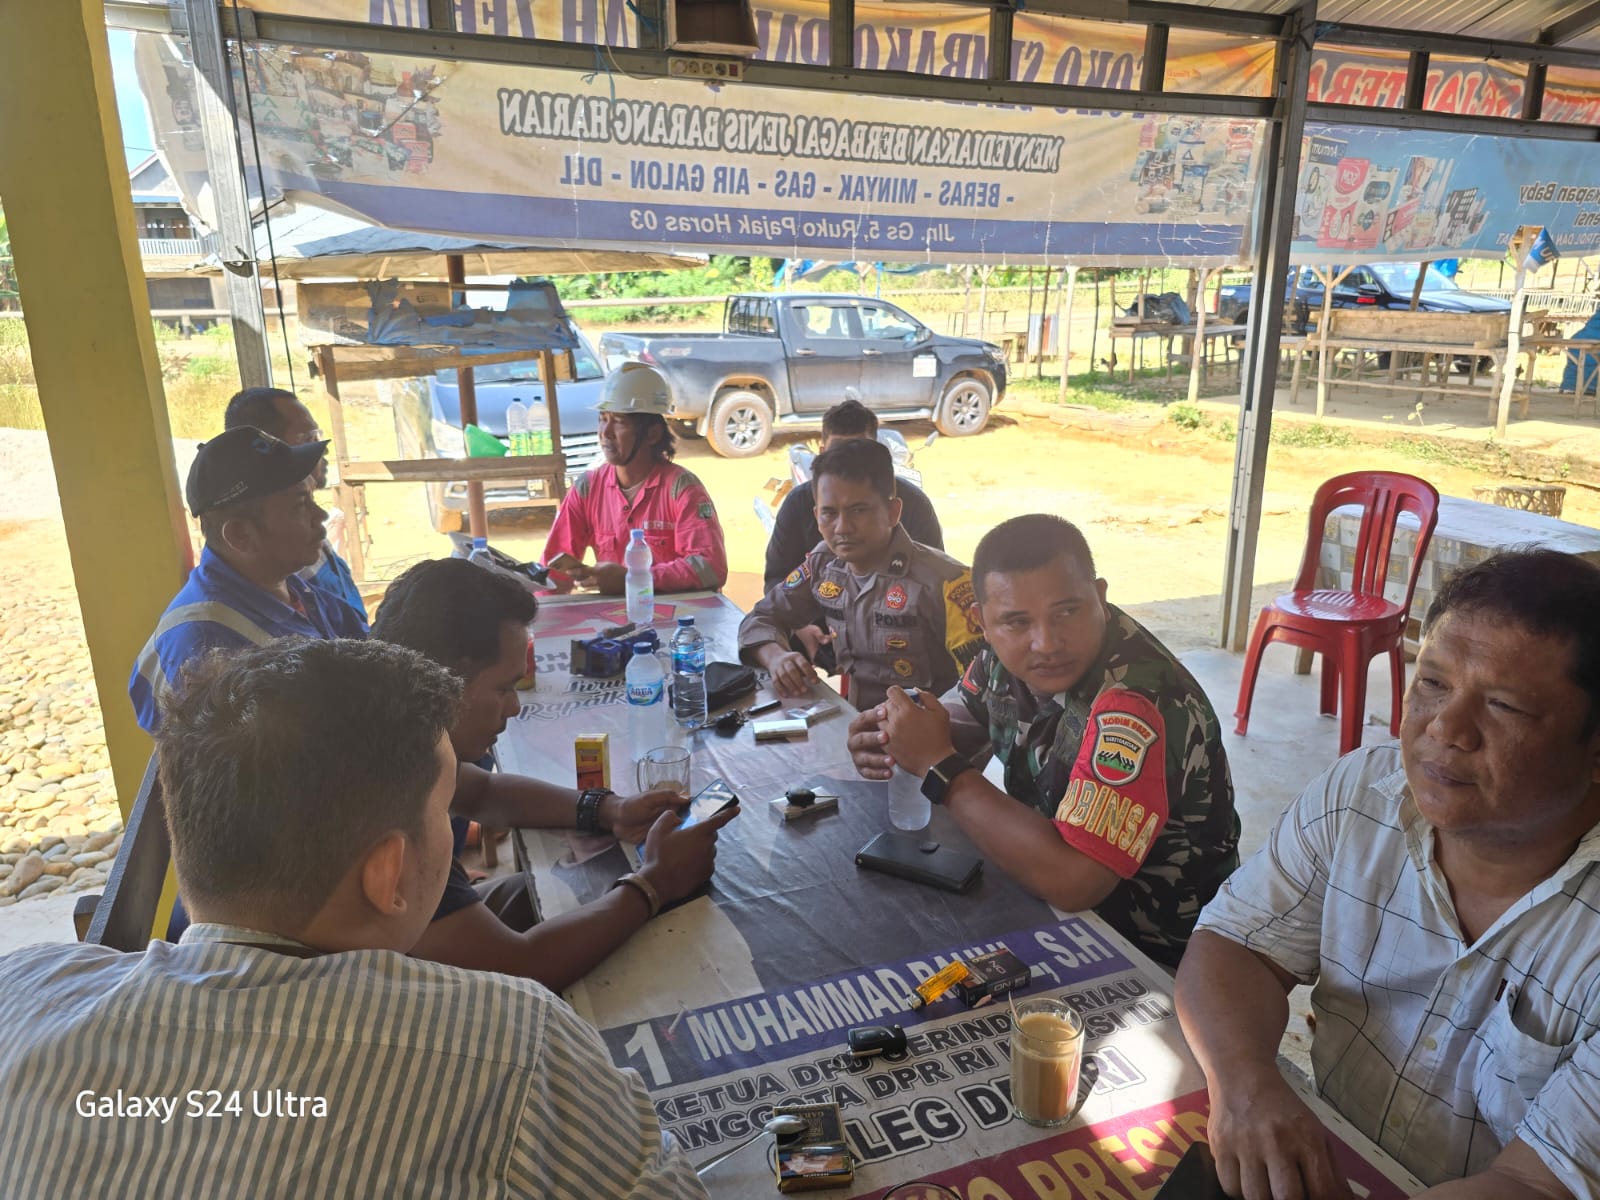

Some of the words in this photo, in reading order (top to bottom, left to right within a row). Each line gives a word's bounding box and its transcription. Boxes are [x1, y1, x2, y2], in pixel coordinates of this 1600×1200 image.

[875, 612, 918, 627] POLRI
[630, 686, 653, 697] AQUA
[624, 1021, 672, 1086] 1
[686, 968, 908, 1061] MUHAMMAD
[1033, 922, 1115, 969] S.H
[655, 1073, 789, 1124] KETUA
[1060, 978, 1150, 1014] RIAU
[863, 1060, 953, 1099] DPR
[950, 1046, 999, 1076] RI
[1126, 998, 1175, 1026] III
